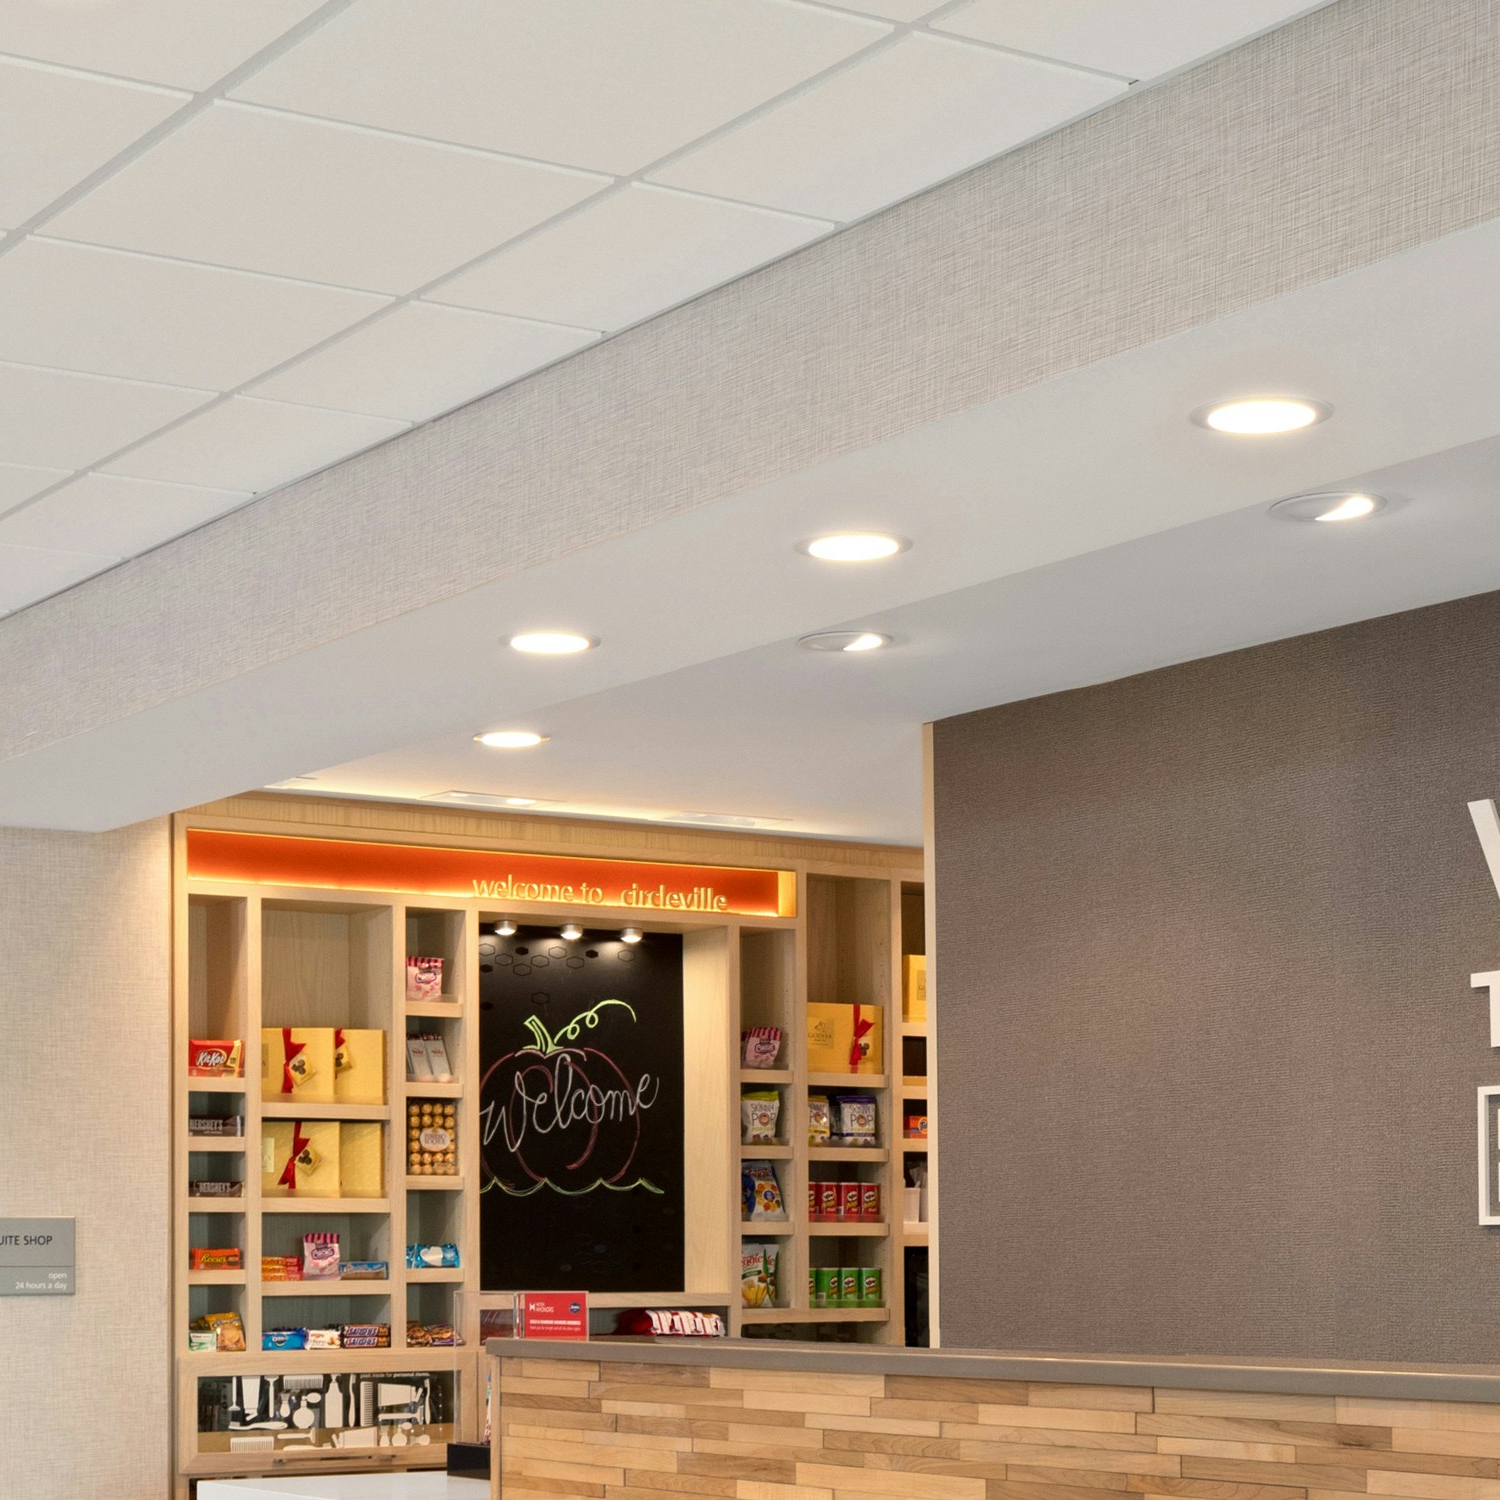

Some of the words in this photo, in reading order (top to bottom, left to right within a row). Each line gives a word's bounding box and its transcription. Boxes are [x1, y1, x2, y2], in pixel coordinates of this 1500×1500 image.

[472, 874, 574, 901] welcome
[579, 882, 604, 904] to
[620, 883, 728, 911] circleville
[479, 1053, 660, 1153] Welcome
[23, 1235, 53, 1246] SHOP
[48, 1272, 68, 1280] open
[15, 1281, 25, 1290] 24
[26, 1281, 46, 1290] hours
[54, 1281, 68, 1291] day
